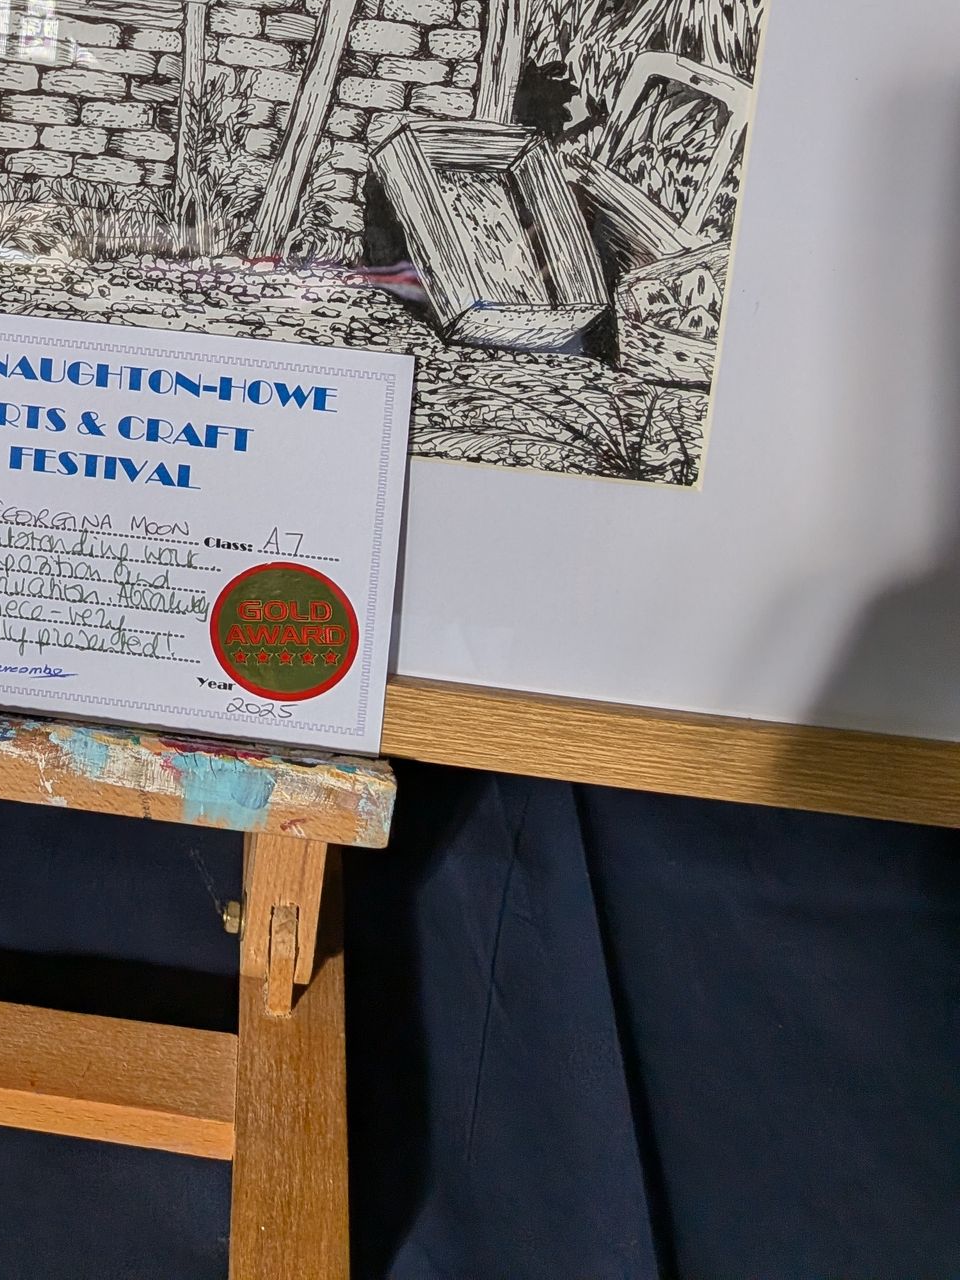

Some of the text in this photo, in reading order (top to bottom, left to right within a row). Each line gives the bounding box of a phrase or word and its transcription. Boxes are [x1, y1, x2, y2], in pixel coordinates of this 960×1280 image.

[78, 411, 106, 437] &
[118, 416, 254, 451] CRAFT
[9, 446, 201, 489] FESTIVAL
[204, 536, 253, 553] Class:
[263, 527, 303, 556] A7
[238, 599, 333, 622] GOLD
[225, 623, 347, 647] AWARD
[226, 697, 299, 719] 2025
